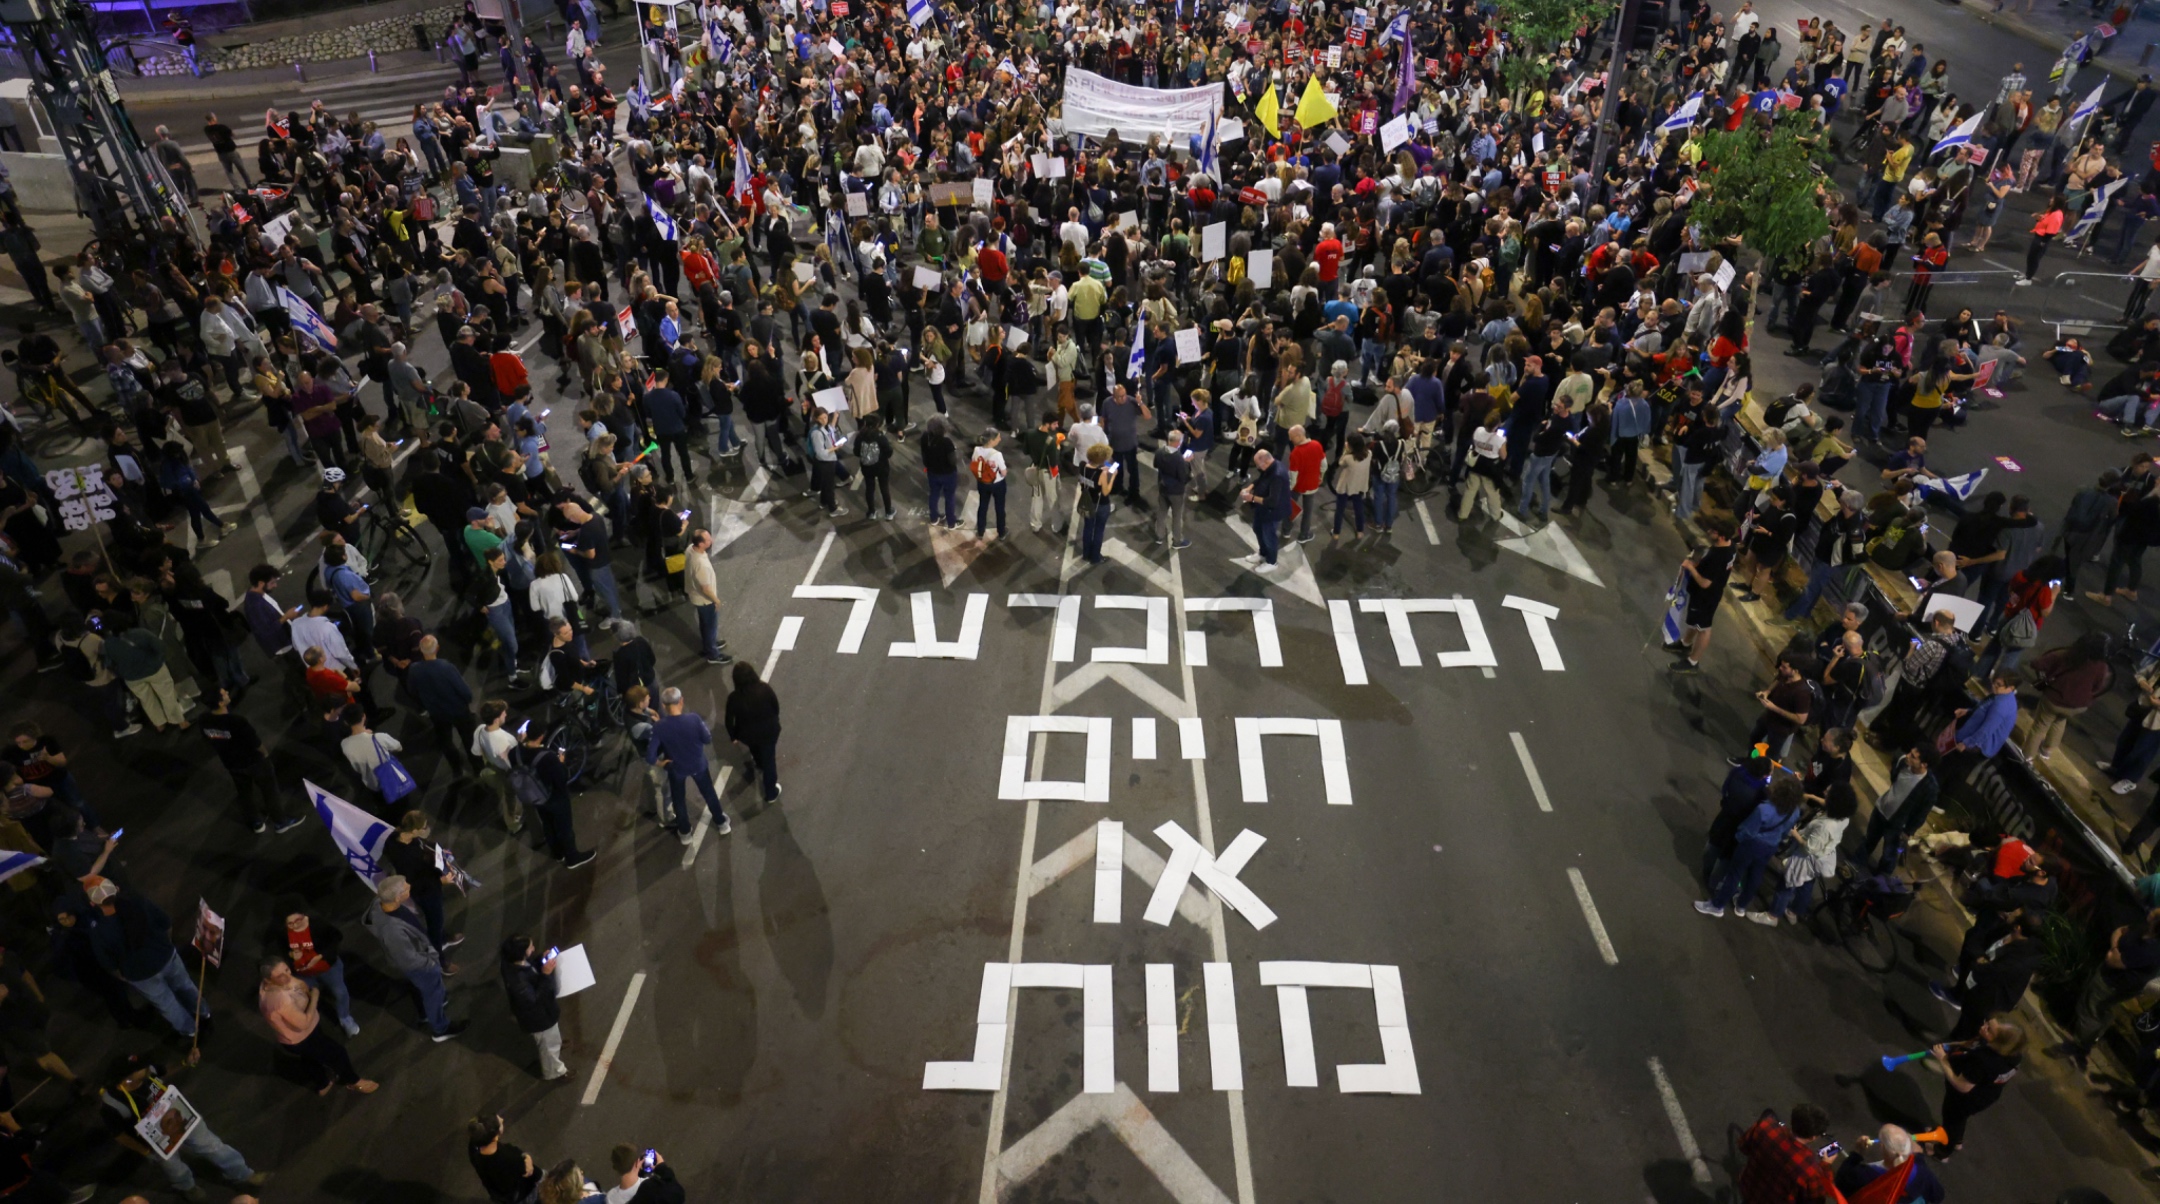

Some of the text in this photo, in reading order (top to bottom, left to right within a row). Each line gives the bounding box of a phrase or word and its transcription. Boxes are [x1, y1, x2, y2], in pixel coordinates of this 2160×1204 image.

[772, 585, 1566, 685] זמן הכרעה
[999, 716, 1353, 804] חיים
[1094, 820, 1278, 930] או
[923, 961, 1421, 1095] מוות
